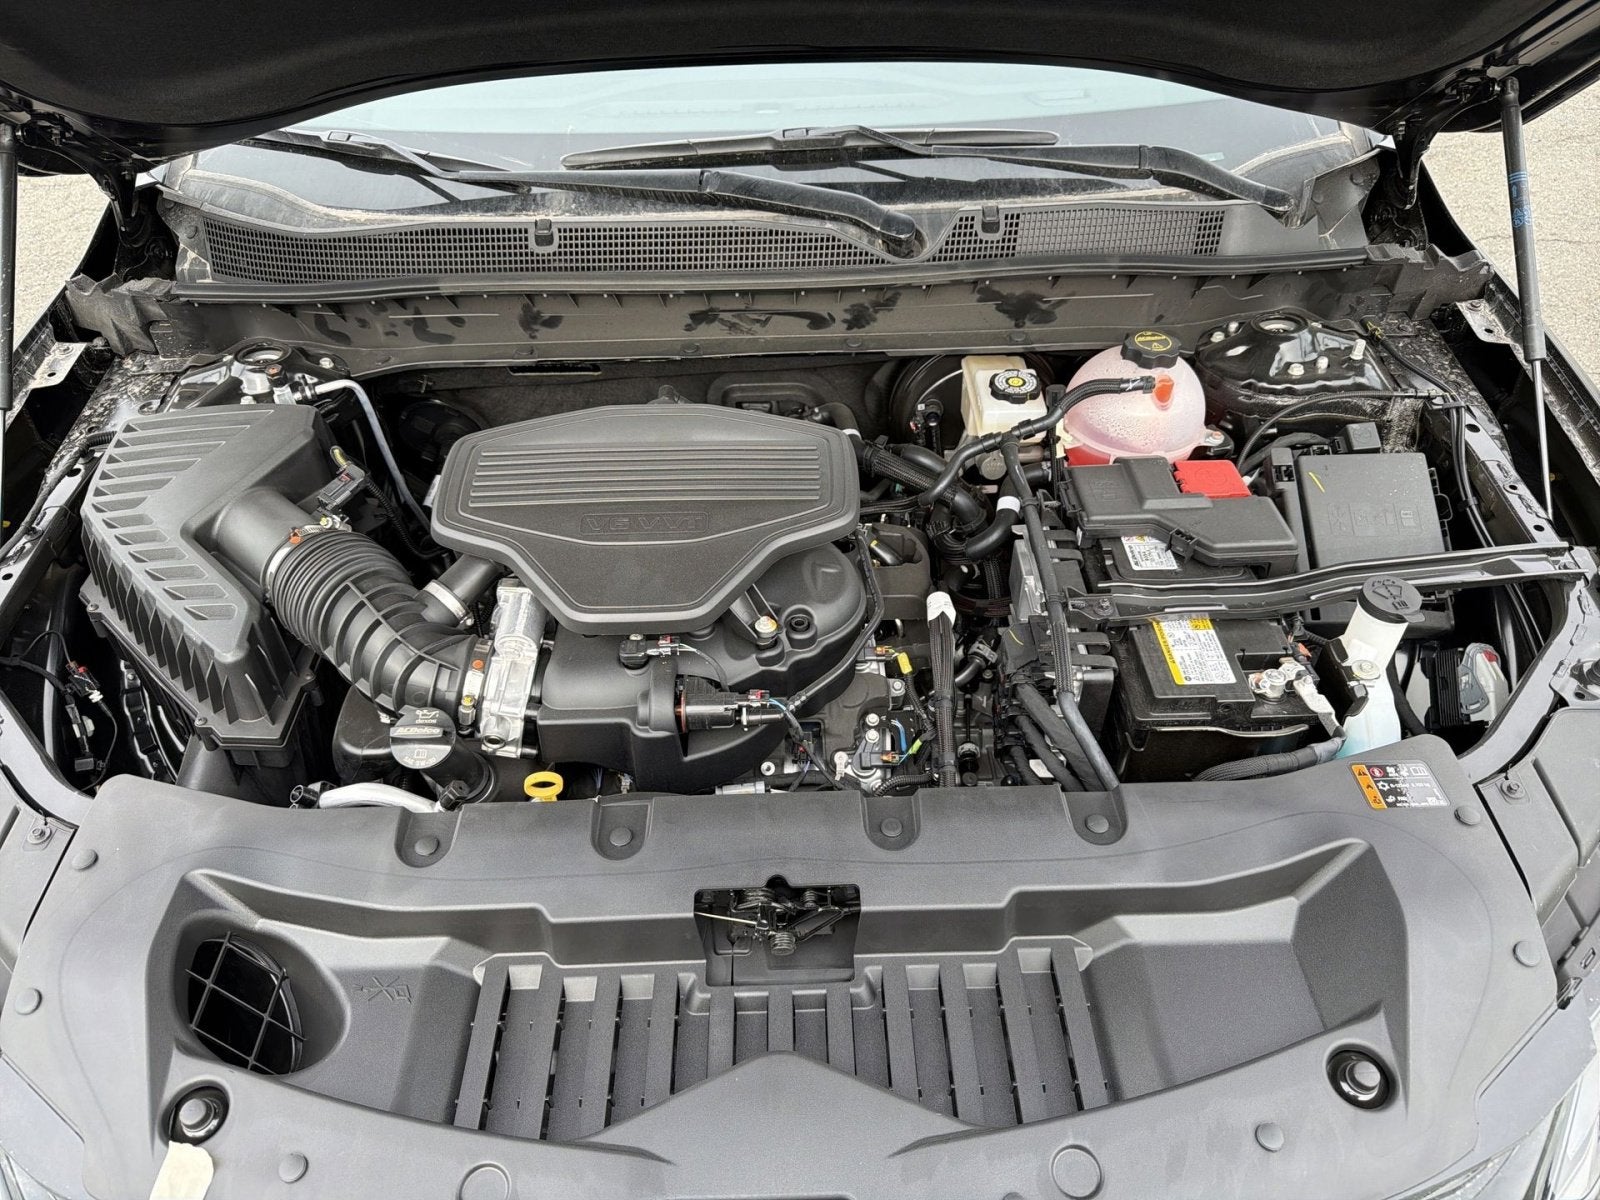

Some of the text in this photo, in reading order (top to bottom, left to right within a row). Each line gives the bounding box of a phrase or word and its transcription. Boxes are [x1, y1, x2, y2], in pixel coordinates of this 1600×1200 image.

[586, 516, 704, 531] V6 VVT
[396, 727, 441, 735] ACDelco
